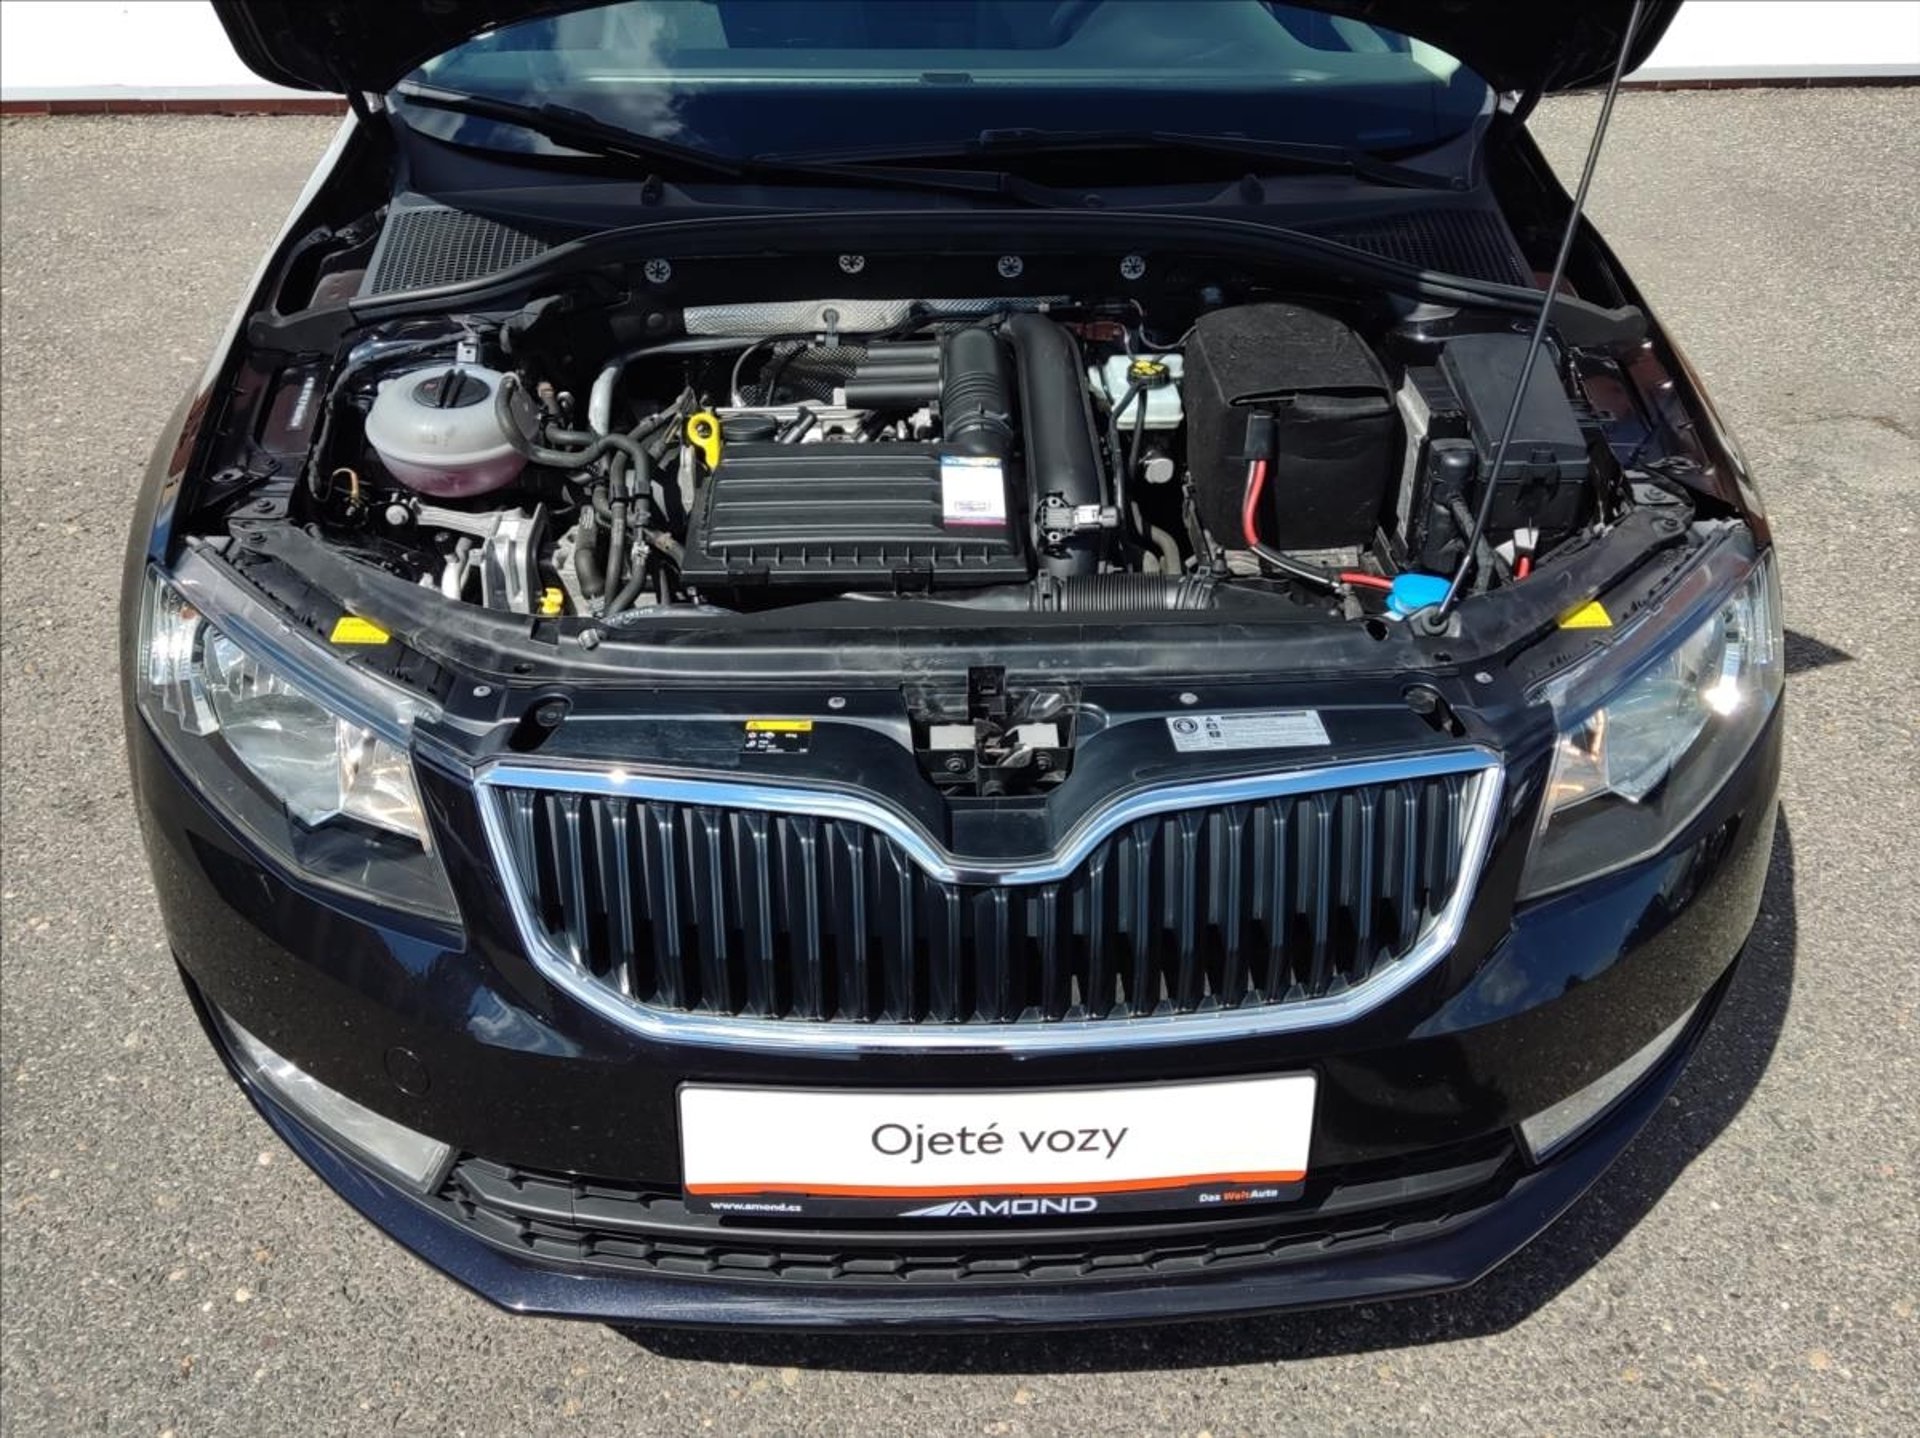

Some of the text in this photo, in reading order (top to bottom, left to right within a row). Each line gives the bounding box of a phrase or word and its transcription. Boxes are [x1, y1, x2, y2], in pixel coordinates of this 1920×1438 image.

[871, 1122, 1129, 1164] Ojeté vozy
[950, 1197, 1098, 1216] AMOND
